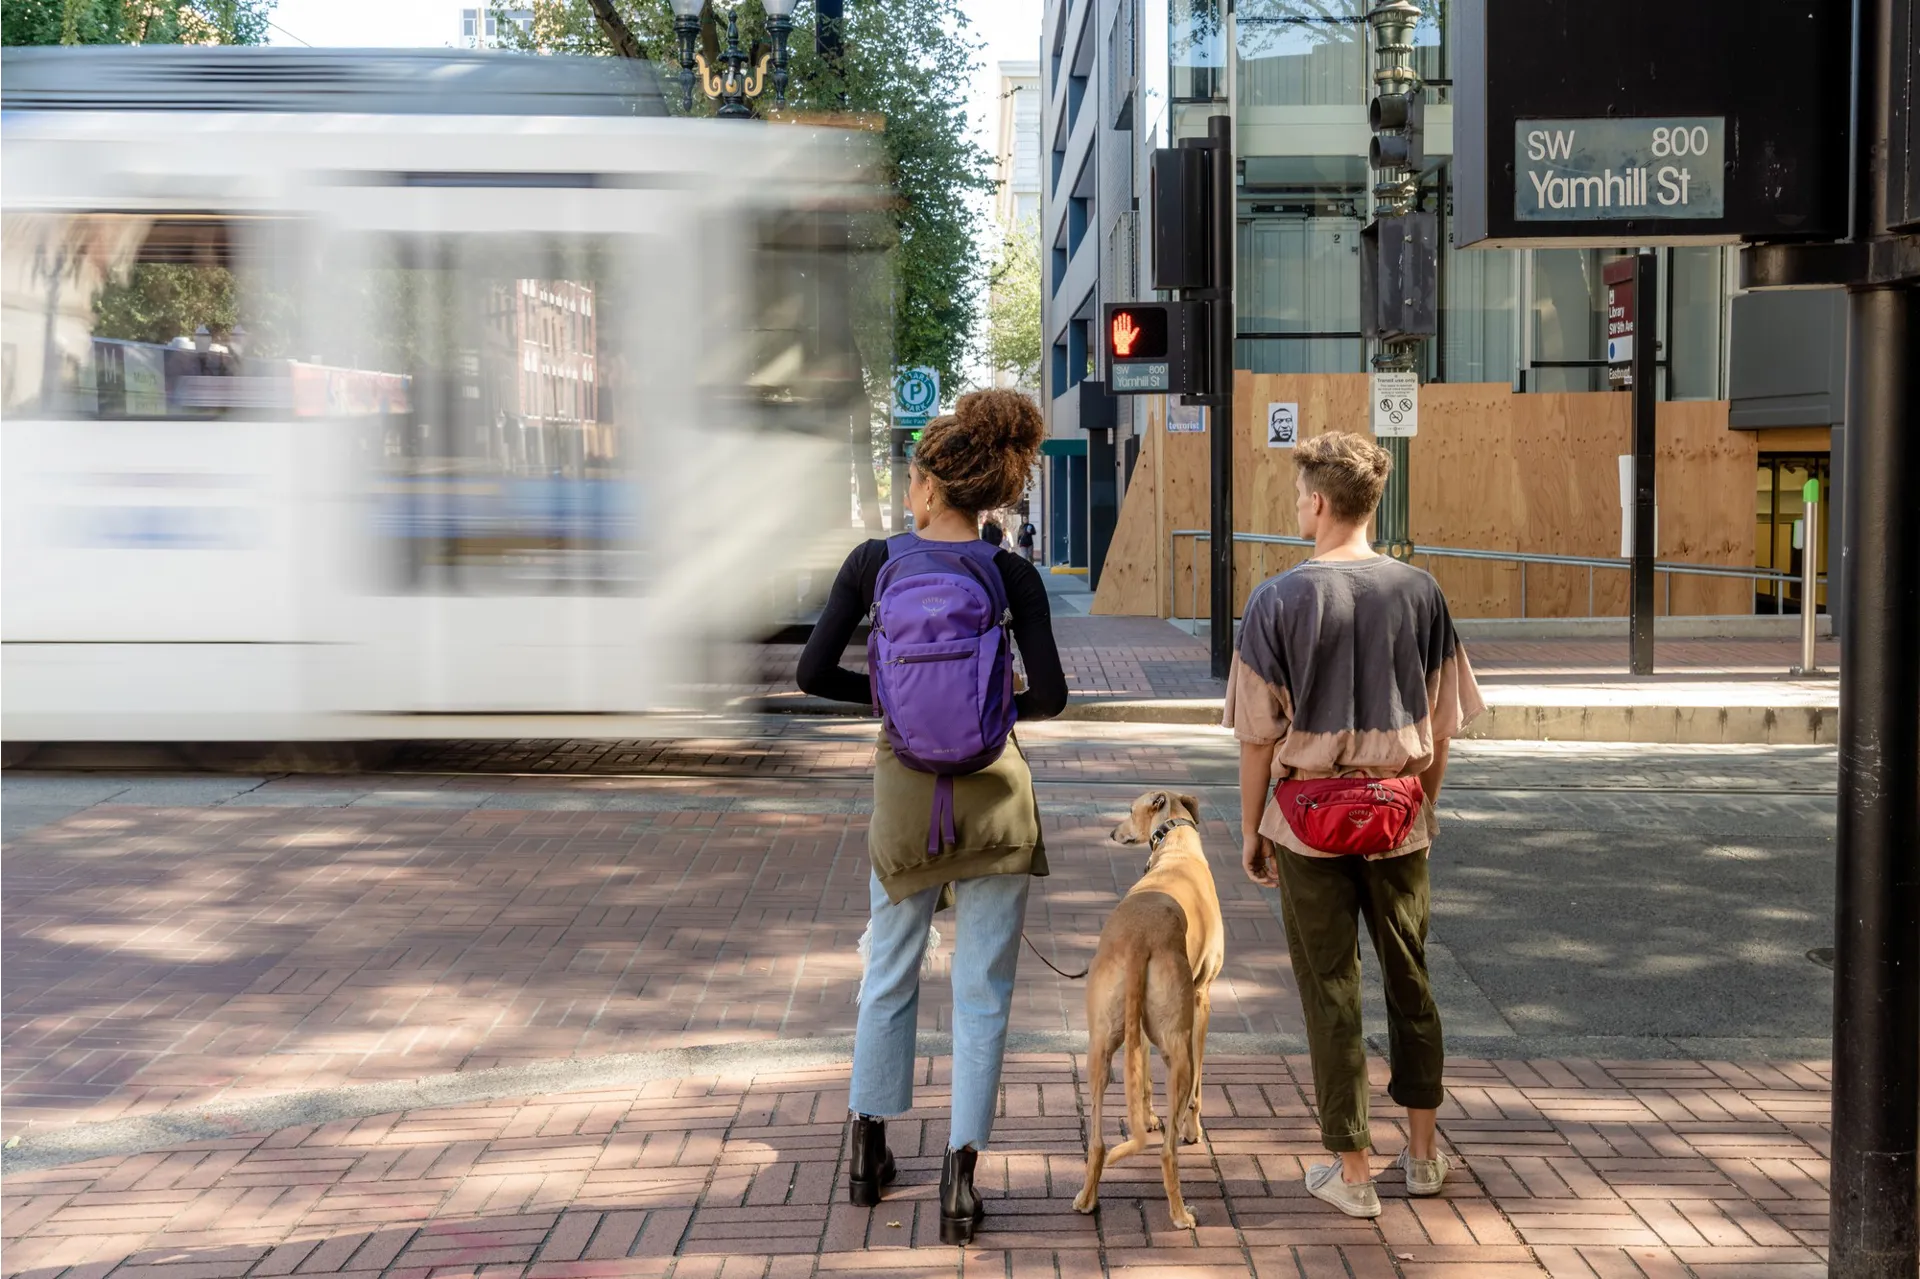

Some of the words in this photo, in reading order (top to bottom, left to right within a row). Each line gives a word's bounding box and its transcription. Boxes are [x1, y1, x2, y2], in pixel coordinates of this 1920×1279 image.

[1528, 130, 1575, 160] SW
[1651, 126, 1708, 157] 800
[1528, 167, 1647, 209] Yamhill
[1656, 166, 1691, 205] St
[1333, 233, 1341, 244] 2
[1609, 306, 1625, 319] Library
[1609, 323, 1617, 335] SW
[1617, 321, 1625, 334] 9th
[1625, 320, 1634, 332] Ave
[1116, 366, 1129, 374] SW
[1149, 365, 1165, 374] 800
[1117, 376, 1149, 387] Yamhill
[1150, 375, 1160, 387] St
[910, 383, 922, 401] P
[1169, 422, 1200, 430] terrorist
[1349, 809, 1374, 817] OSPREY
